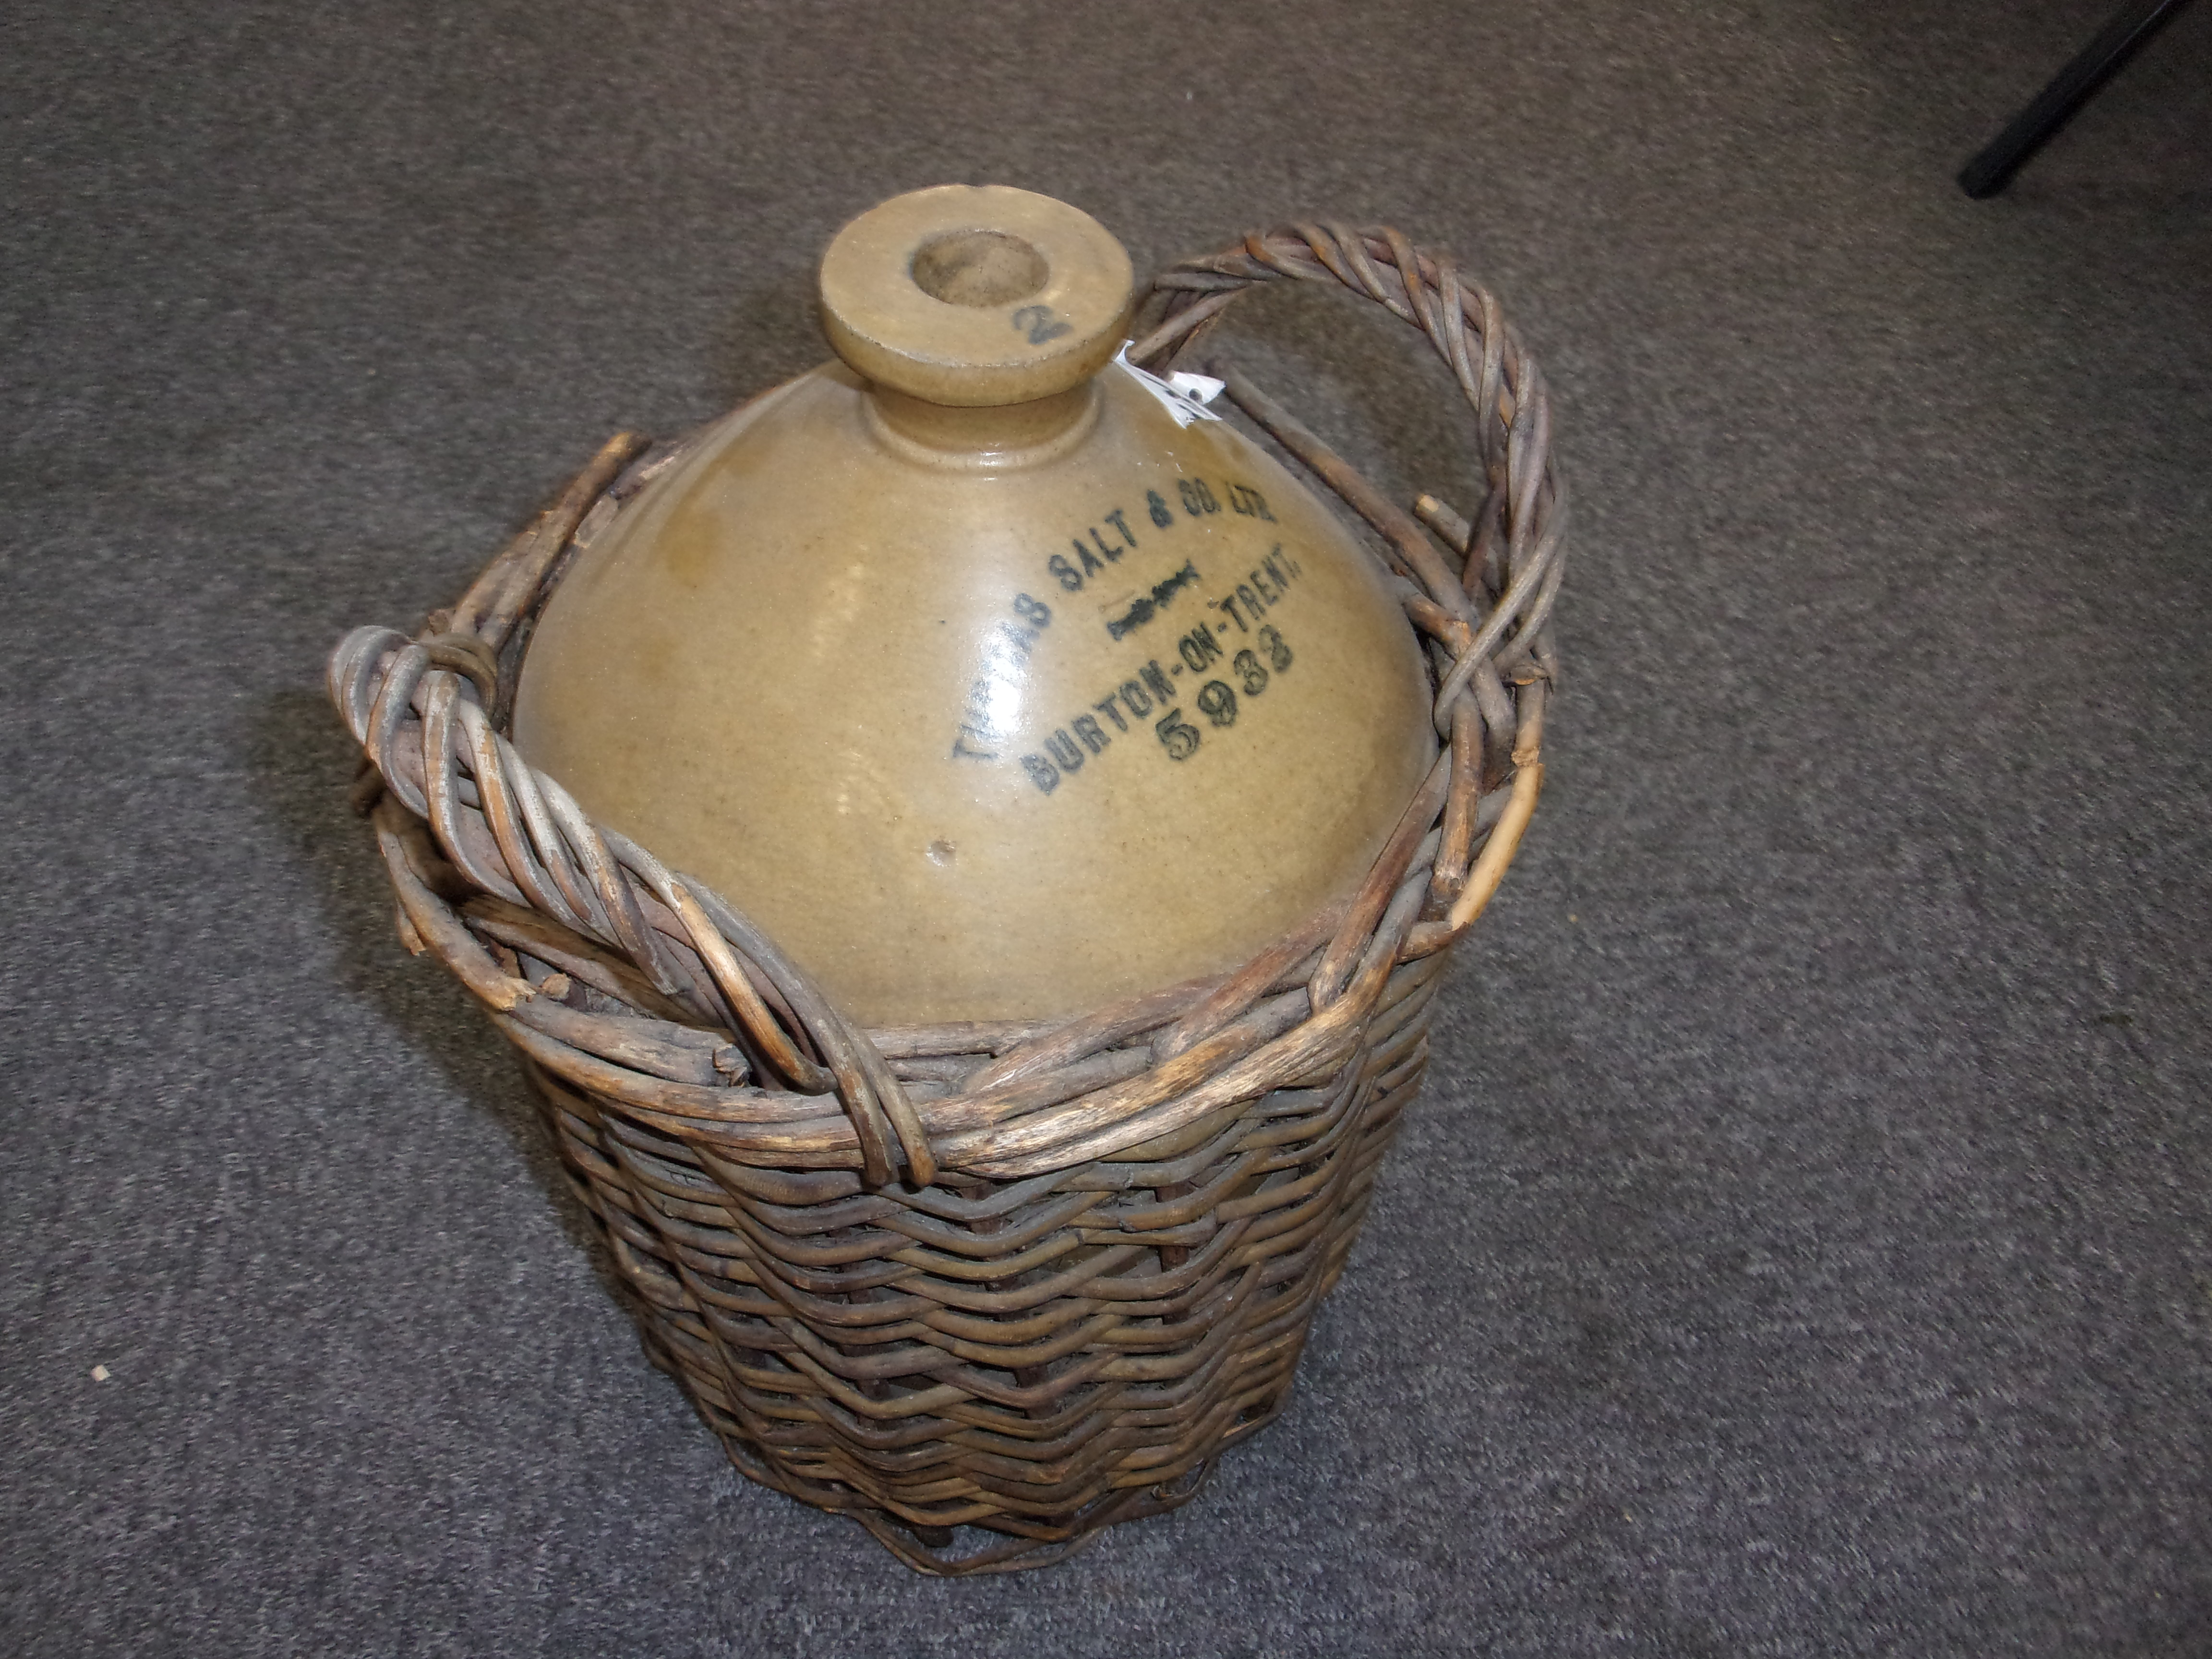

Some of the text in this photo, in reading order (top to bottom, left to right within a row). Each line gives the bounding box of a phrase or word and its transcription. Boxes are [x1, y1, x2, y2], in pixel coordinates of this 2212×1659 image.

[1013, 304, 1073, 346] 2
[1048, 509, 1136, 591] SALT
[1147, 489, 1173, 528] &
